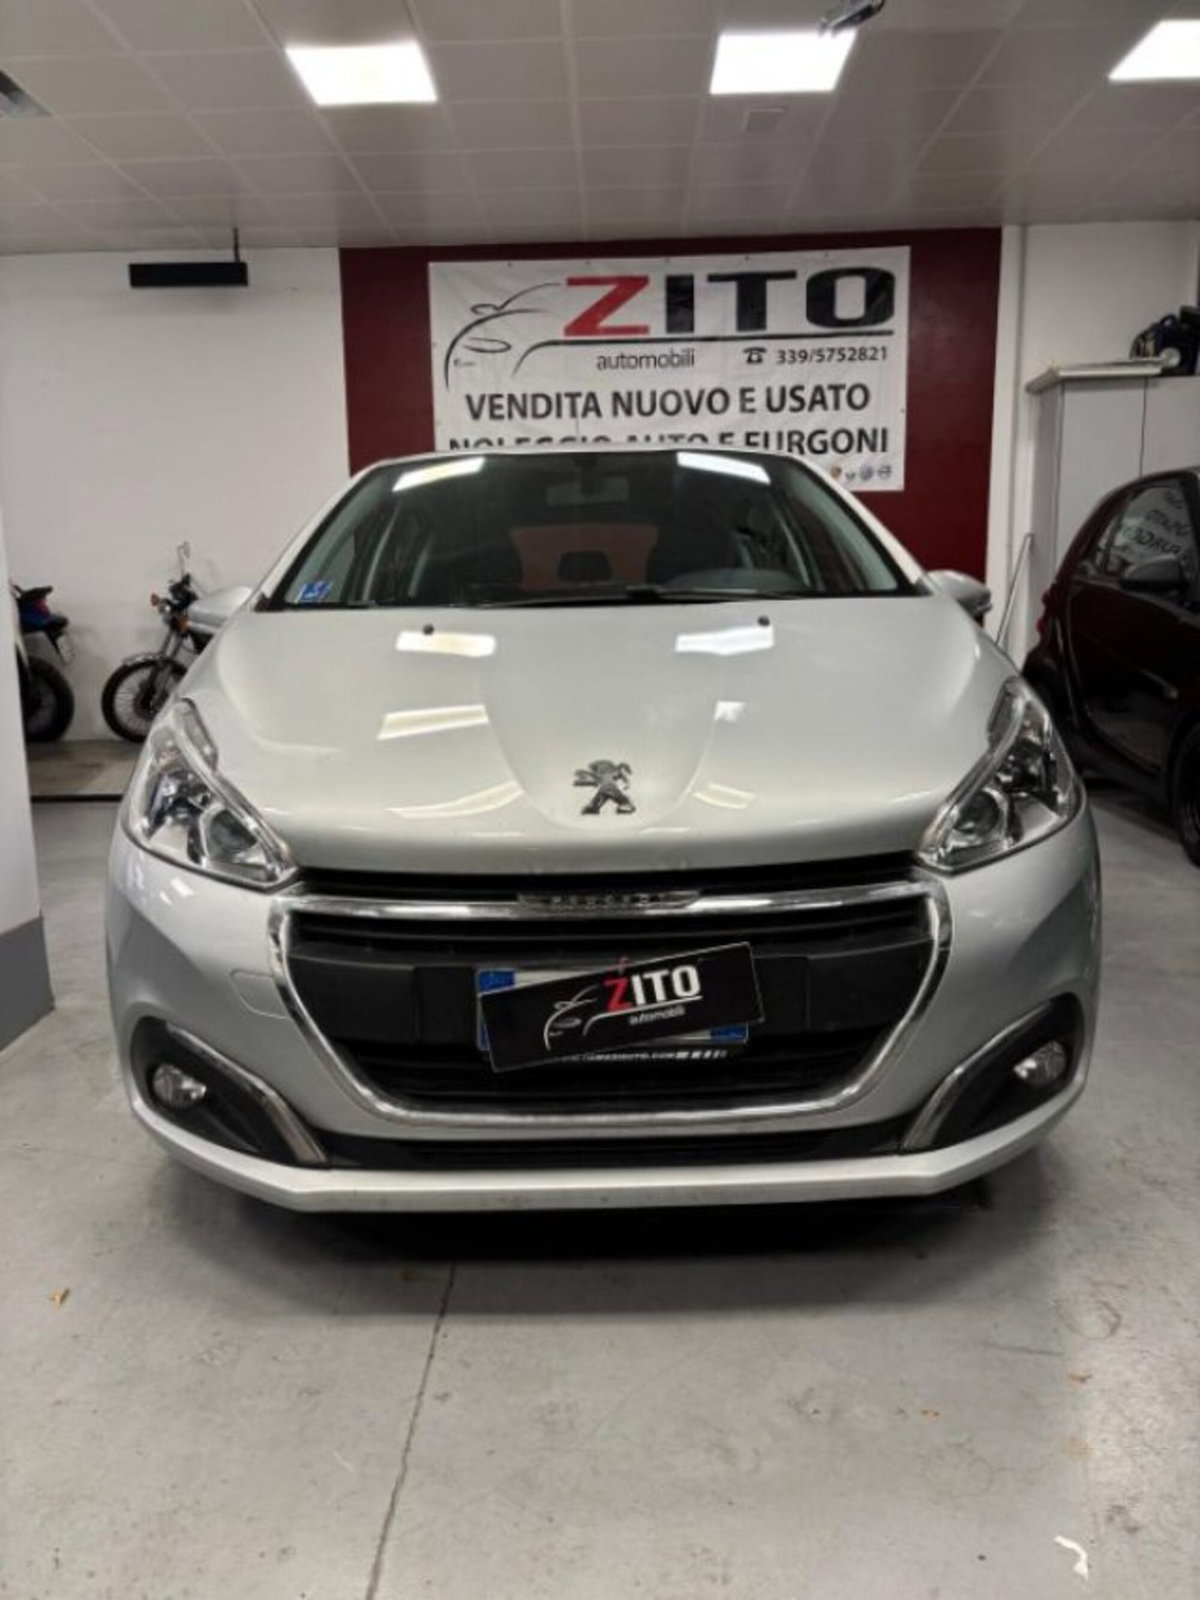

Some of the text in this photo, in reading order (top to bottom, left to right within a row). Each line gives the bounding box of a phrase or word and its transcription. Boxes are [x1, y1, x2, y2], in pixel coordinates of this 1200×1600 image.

[563, 267, 896, 337] ZITO
[596, 349, 696, 370] automobili
[775, 345, 888, 364] 339/5752821
[465, 383, 871, 420] VENDITA NUOVO E USATO
[604, 965, 702, 1011] ZITO
